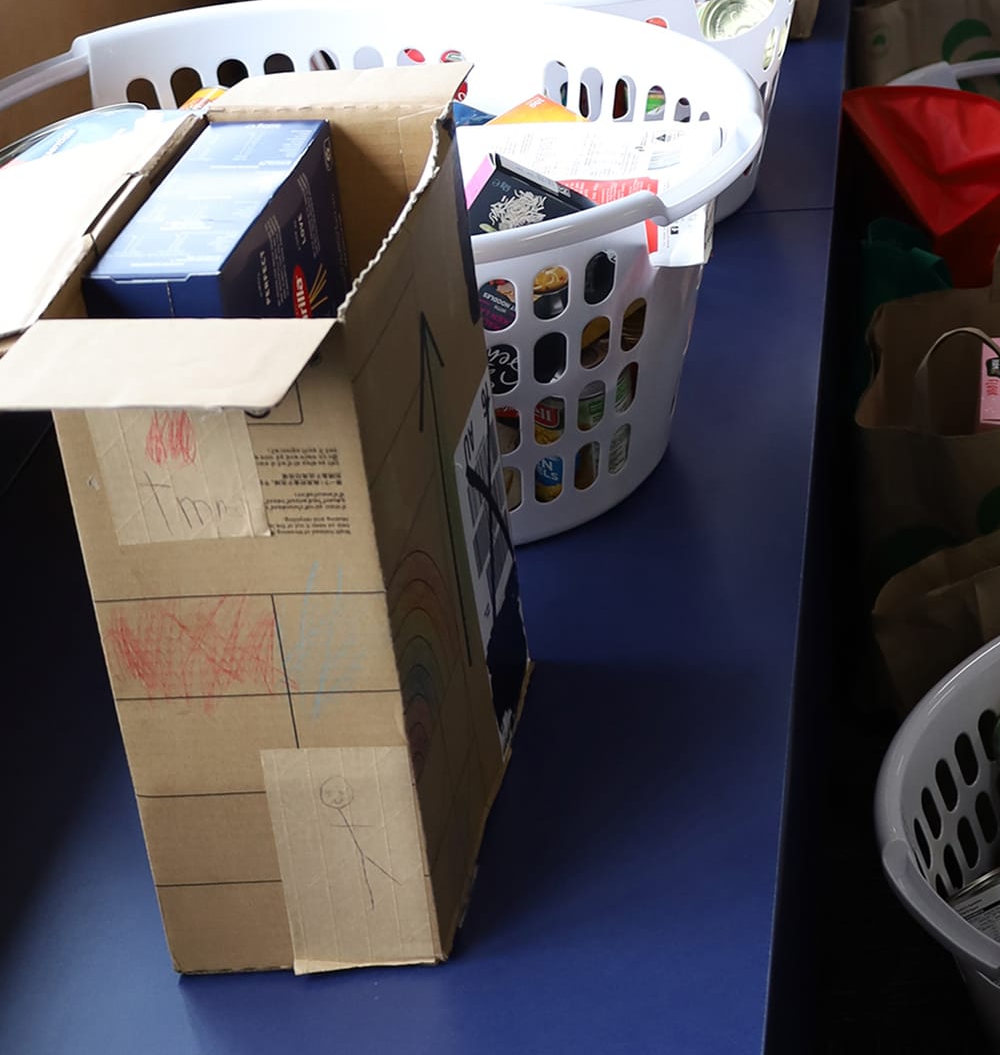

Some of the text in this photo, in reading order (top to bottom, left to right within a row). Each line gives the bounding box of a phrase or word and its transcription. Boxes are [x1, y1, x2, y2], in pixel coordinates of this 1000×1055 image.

[258, 251, 272, 306] PERFECT
[294, 276, 310, 318] rilla
[482, 291, 511, 310] NOODLES
